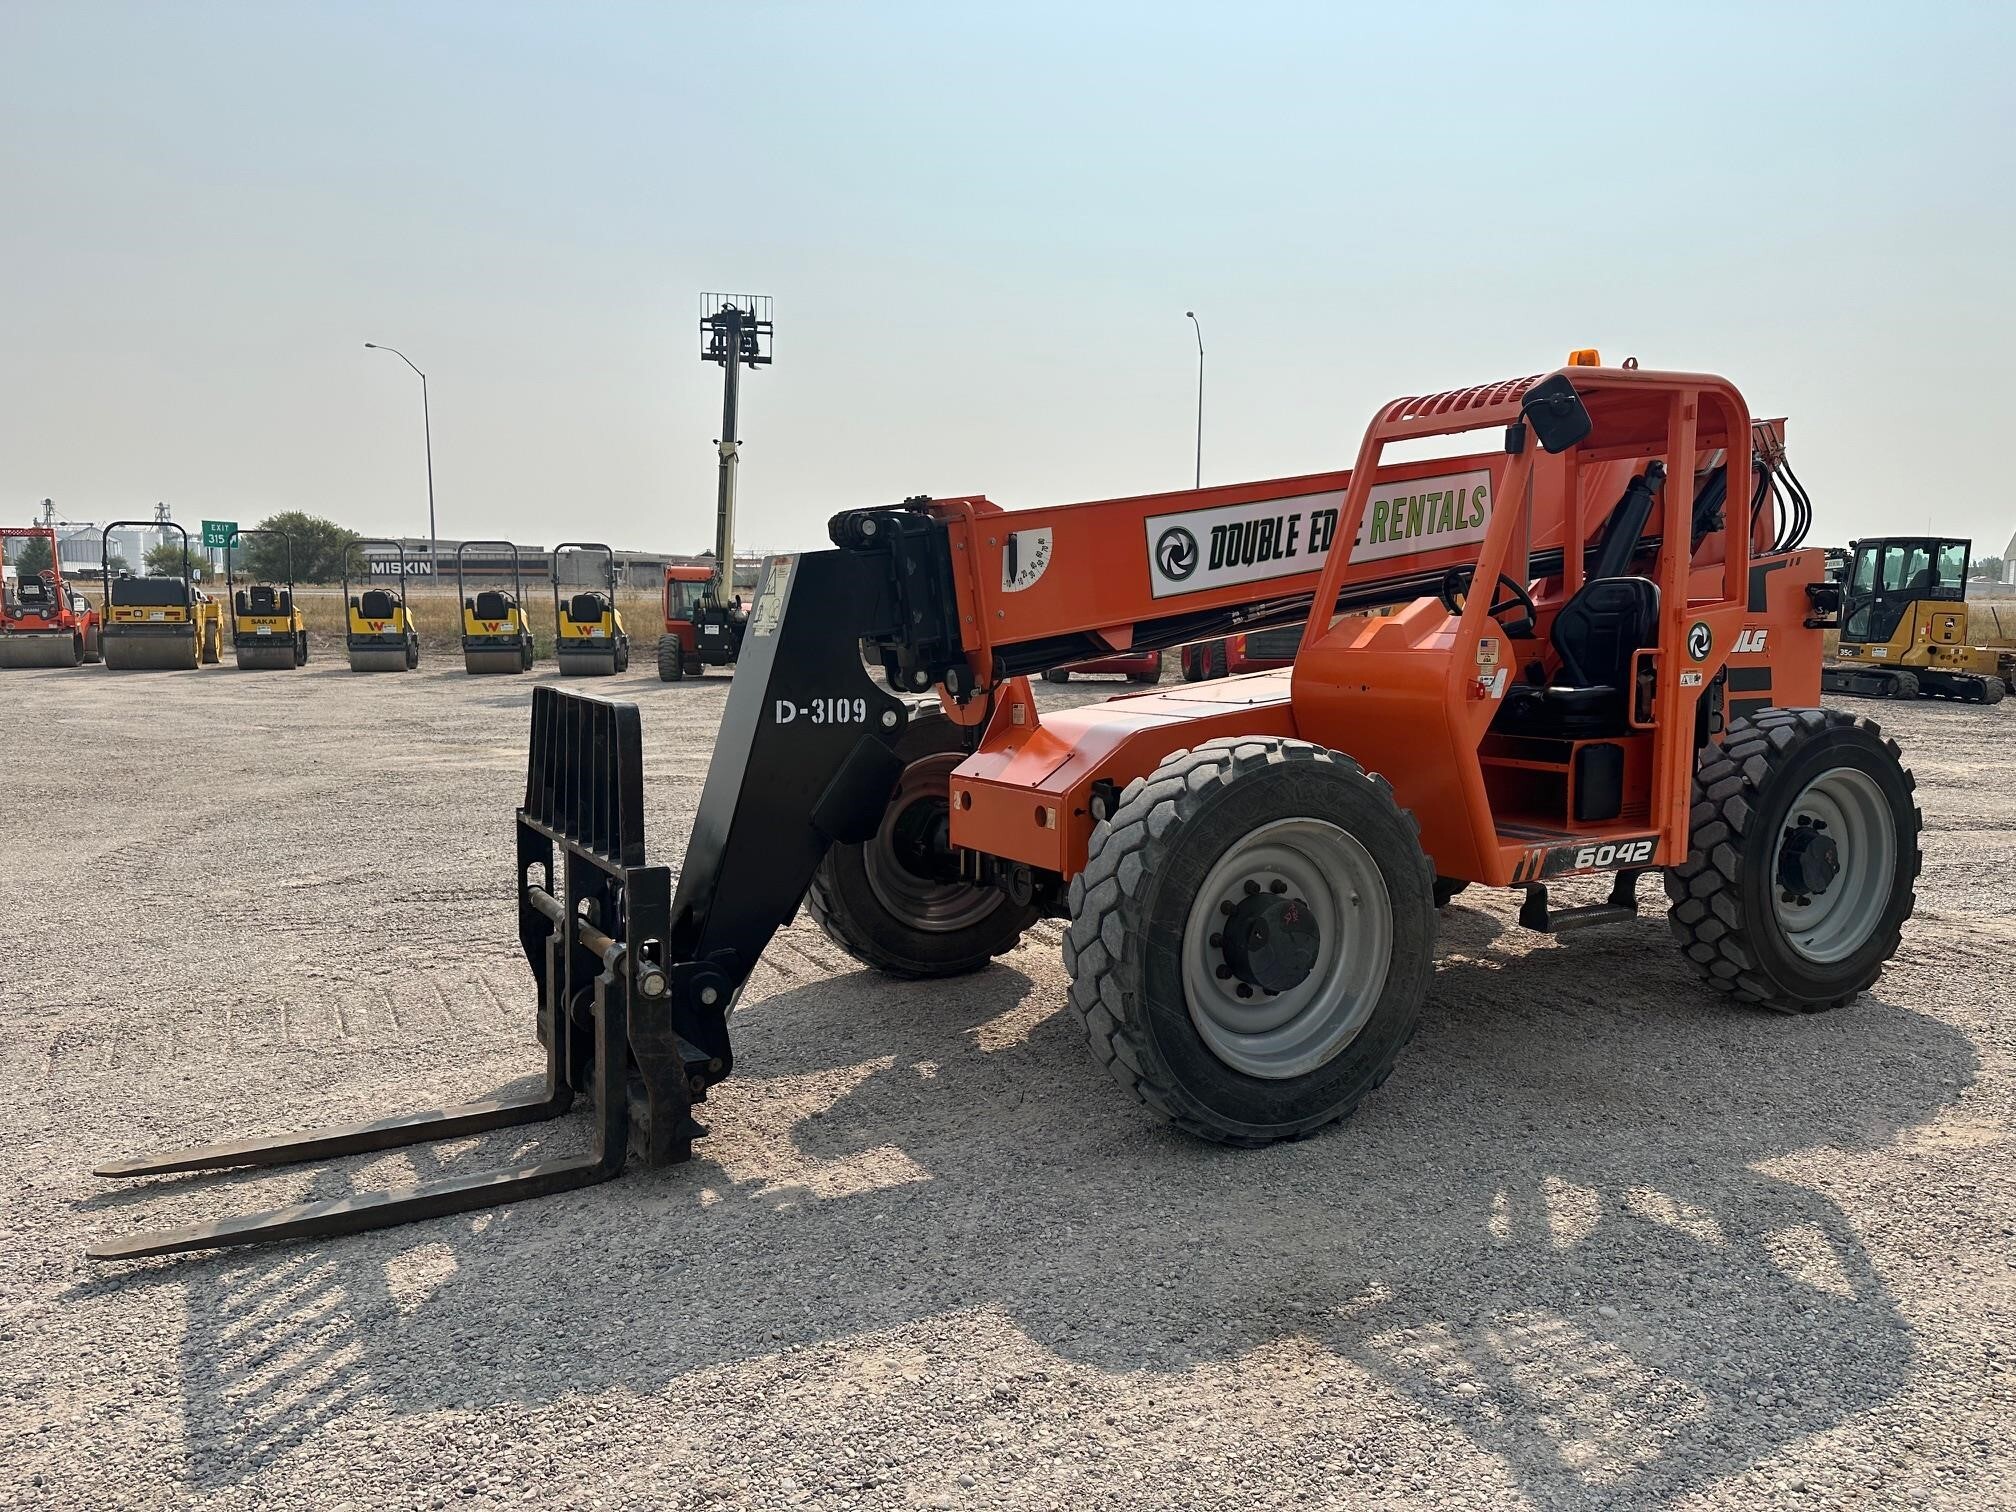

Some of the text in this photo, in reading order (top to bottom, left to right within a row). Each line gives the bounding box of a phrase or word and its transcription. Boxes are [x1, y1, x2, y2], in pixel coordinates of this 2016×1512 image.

[211, 524, 229, 532] EXIT
[1208, 485, 1487, 570] DOUBLE ED RENTALS
[208, 534, 225, 544] 315
[371, 562, 431, 574] MISKIN
[775, 698, 867, 724] D-3109
[1573, 840, 1653, 869] 6042
